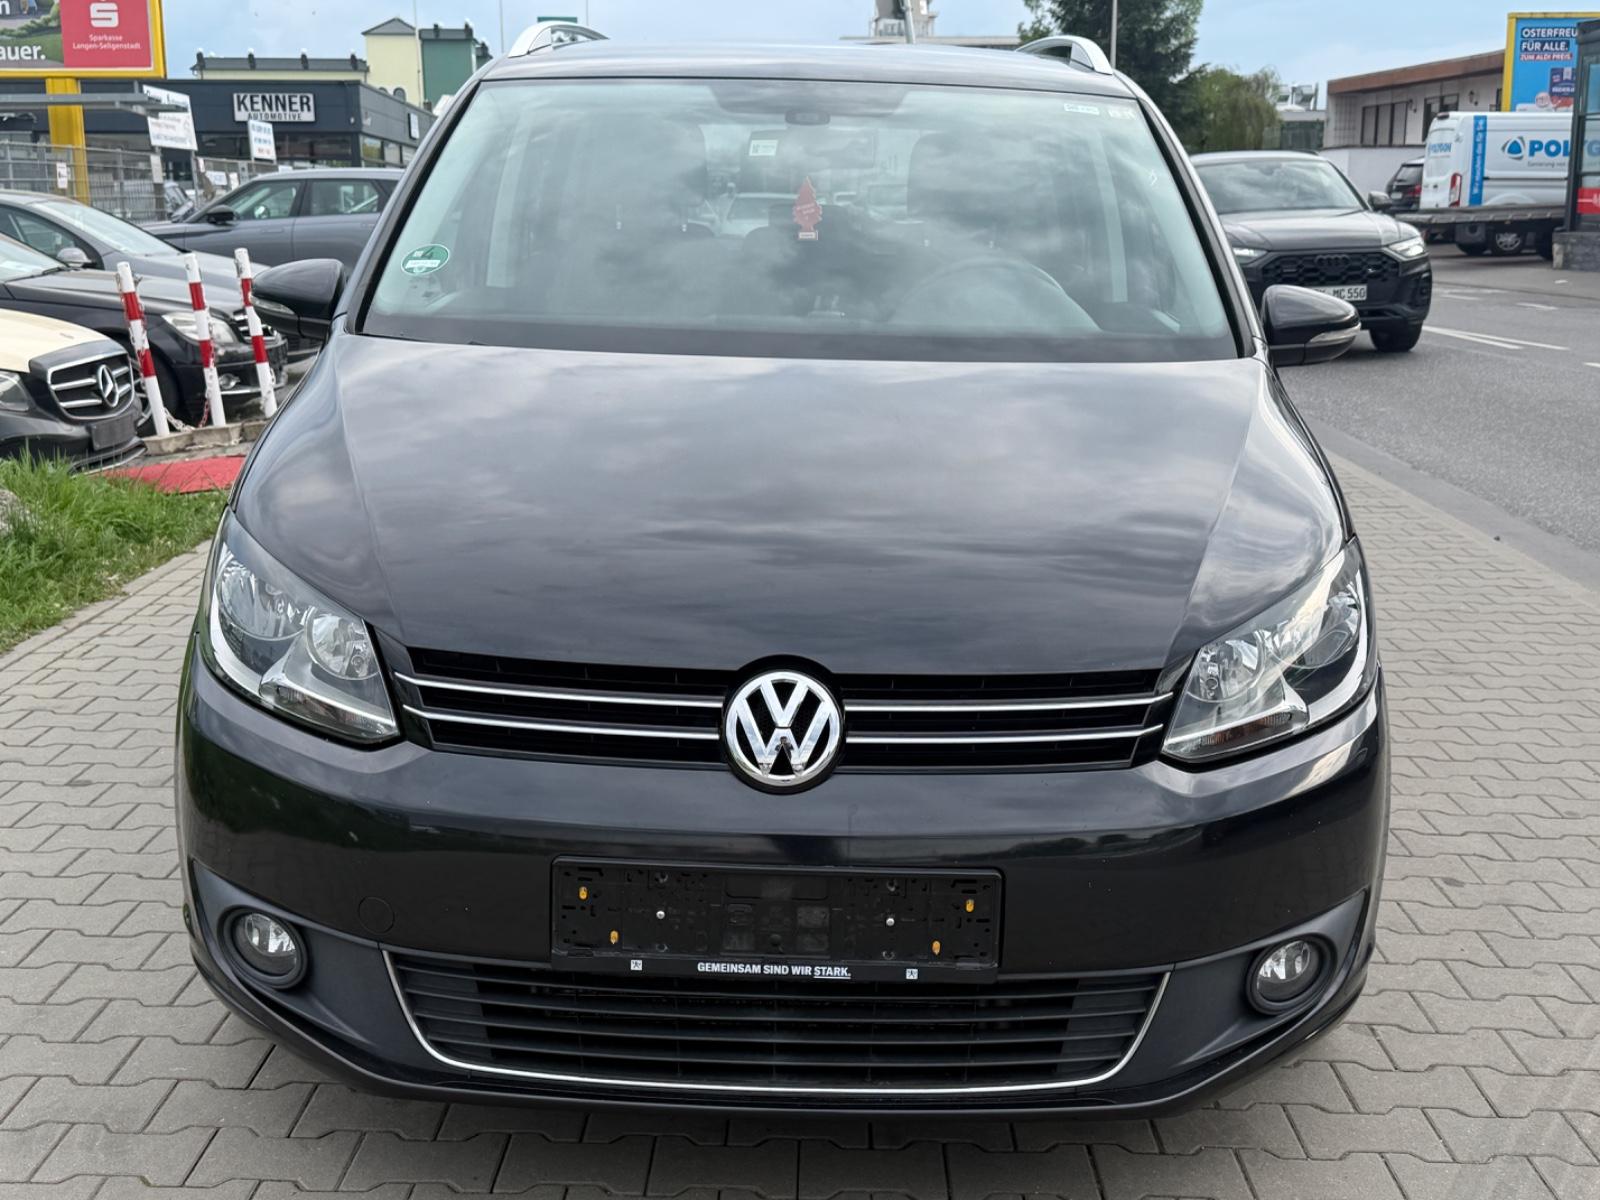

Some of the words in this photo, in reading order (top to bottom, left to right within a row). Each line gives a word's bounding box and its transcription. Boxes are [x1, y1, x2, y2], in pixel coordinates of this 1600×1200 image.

[88, 34, 123, 42] Sparkasse
[72, 42, 141, 50] Langen-Seligenstadt
[1521, 40, 1541, 51] FÜR
[1542, 42, 1568, 51] ALLE.
[236, 94, 311, 112] KENNER
[247, 112, 302, 121] AUTOMOTIVE
[1347, 287, 1366, 299] 550
[697, 962, 761, 974] GEMEINSAM
[763, 965, 789, 975] SIND
[791, 966, 812, 976] WIR
[813, 966, 852, 978] STARK.
